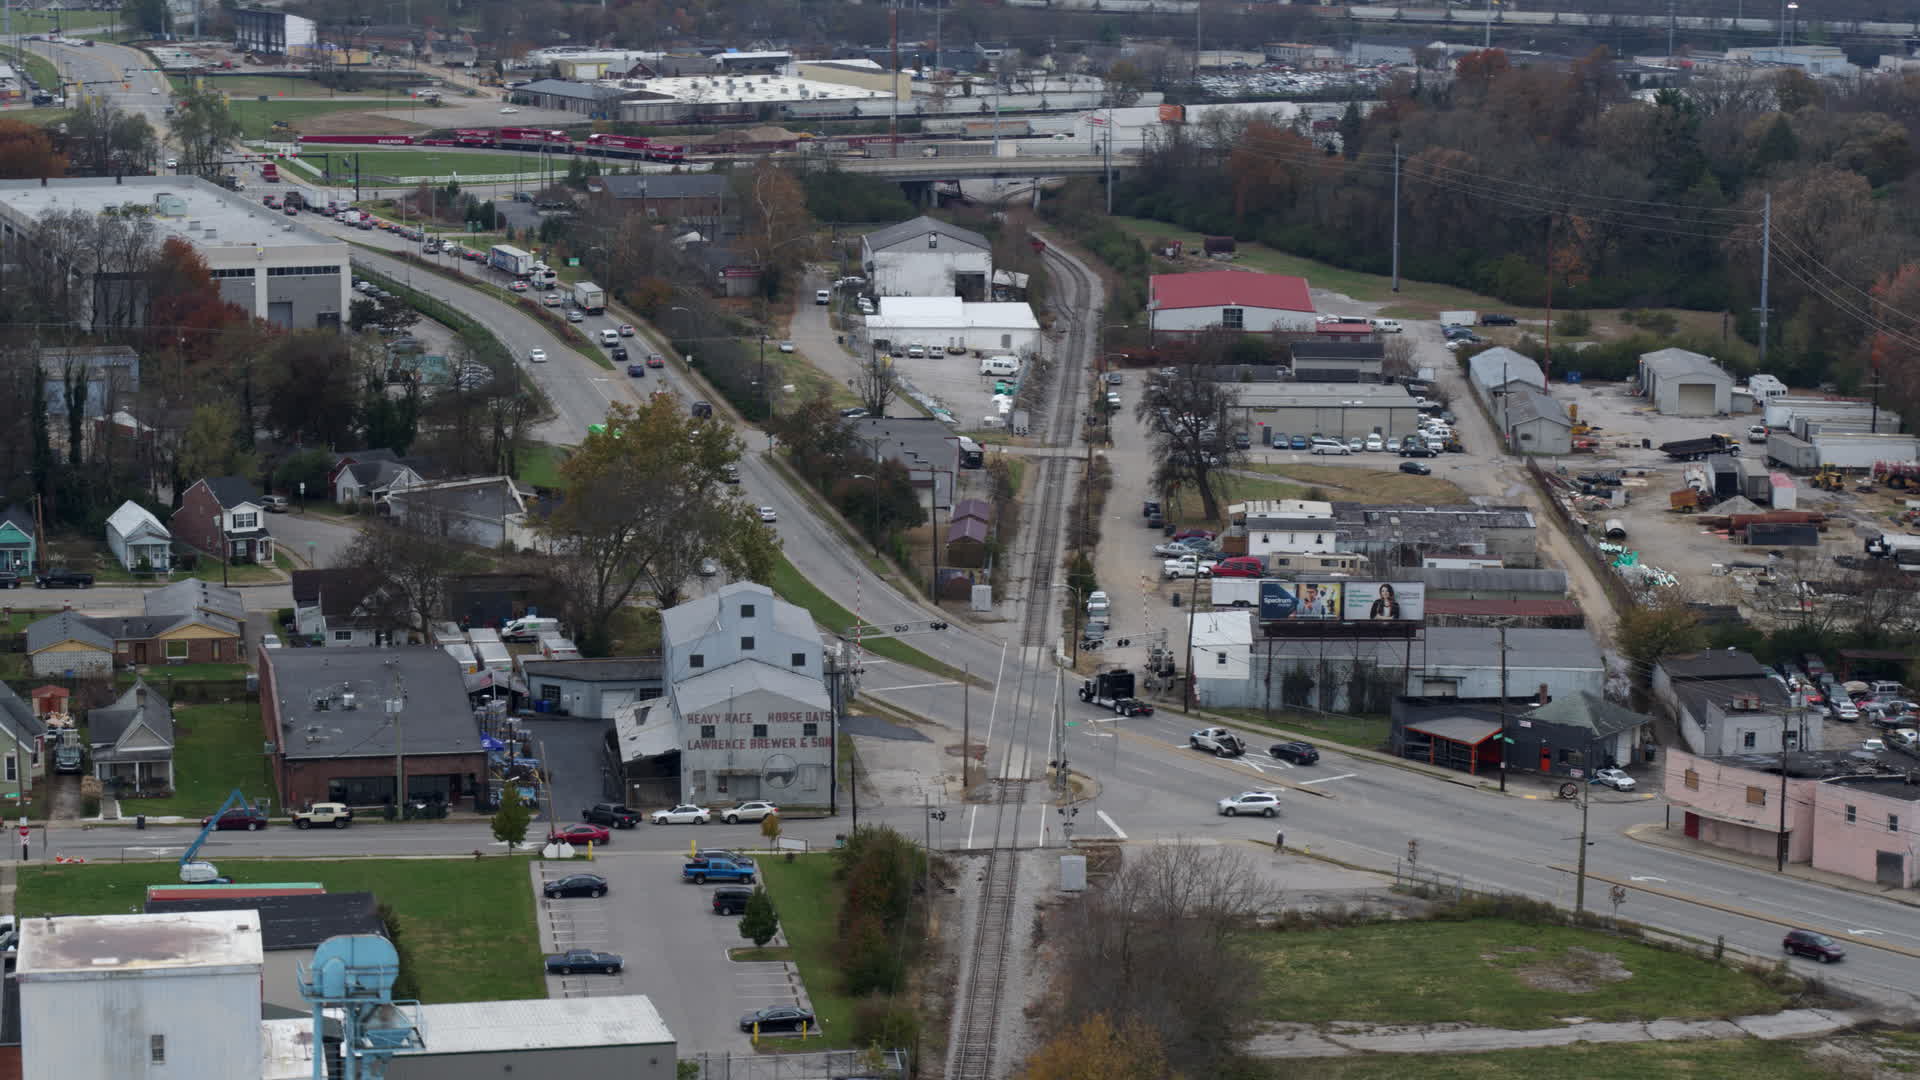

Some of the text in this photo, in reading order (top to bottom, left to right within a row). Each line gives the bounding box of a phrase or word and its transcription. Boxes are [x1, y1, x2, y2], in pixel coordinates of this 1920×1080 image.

[687, 711, 832, 724] HEAVY RACE HORSE OATS
[687, 736, 833, 751] LAWRENCE BREWER & SON
